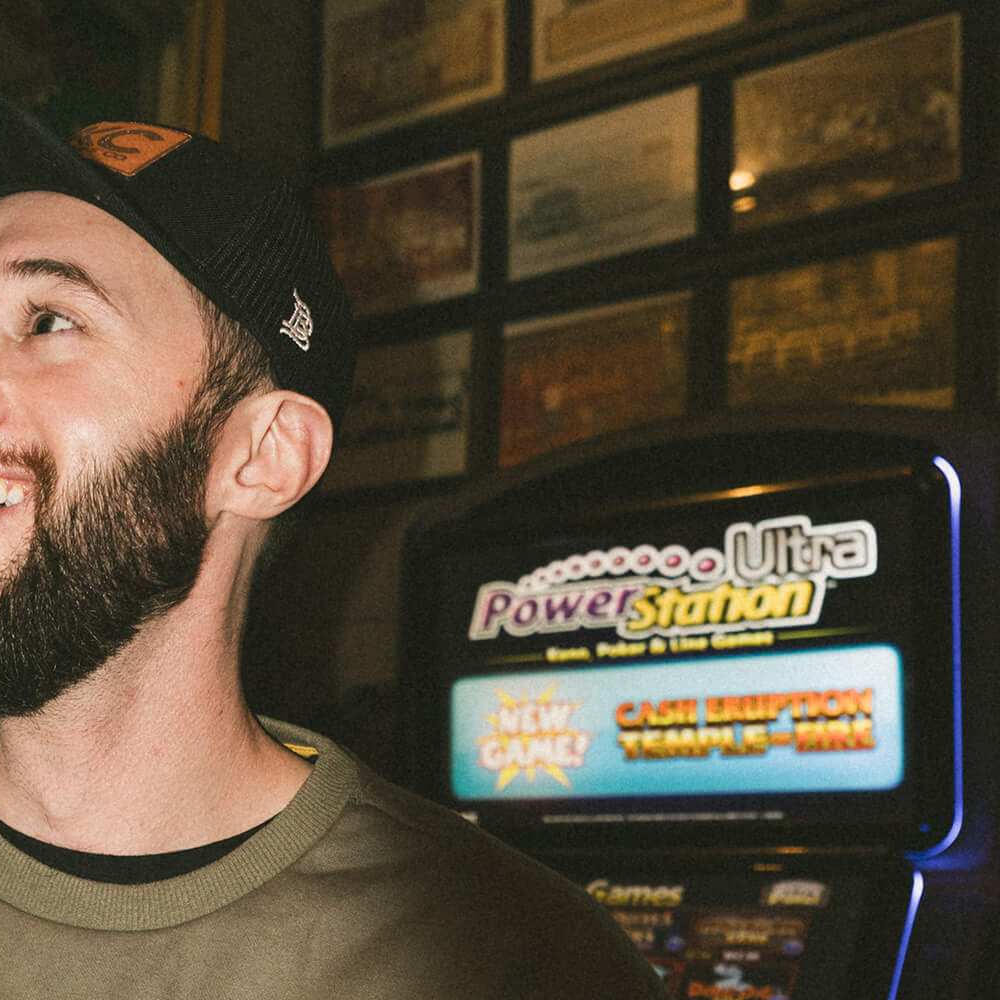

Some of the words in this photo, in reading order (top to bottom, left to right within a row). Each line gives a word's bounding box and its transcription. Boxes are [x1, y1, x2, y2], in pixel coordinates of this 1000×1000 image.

[731, 522, 874, 580] Ultra
[499, 700, 575, 734] NEW
[615, 698, 699, 729] CASH
[705, 688, 874, 726] ERUPTION
[478, 732, 592, 771] GAME!
